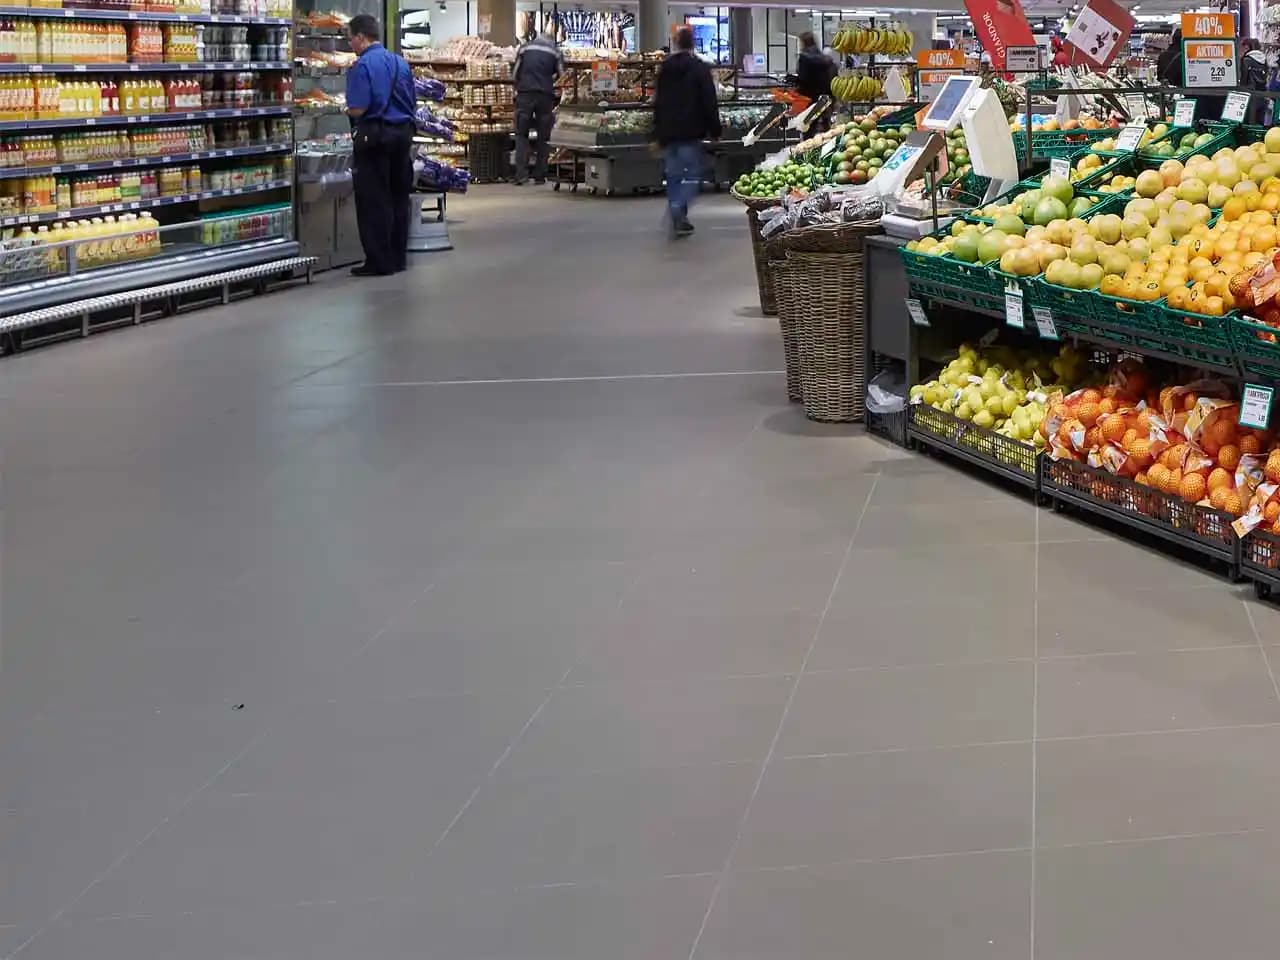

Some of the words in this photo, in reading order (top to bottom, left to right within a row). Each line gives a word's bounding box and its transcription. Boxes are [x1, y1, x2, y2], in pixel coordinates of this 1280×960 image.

[1194, 16, 1223, 35] 40%
[1196, 45, 1224, 57] AKTION
[928, 52, 954, 66] 40%
[1211, 67, 1225, 77] 2.20
